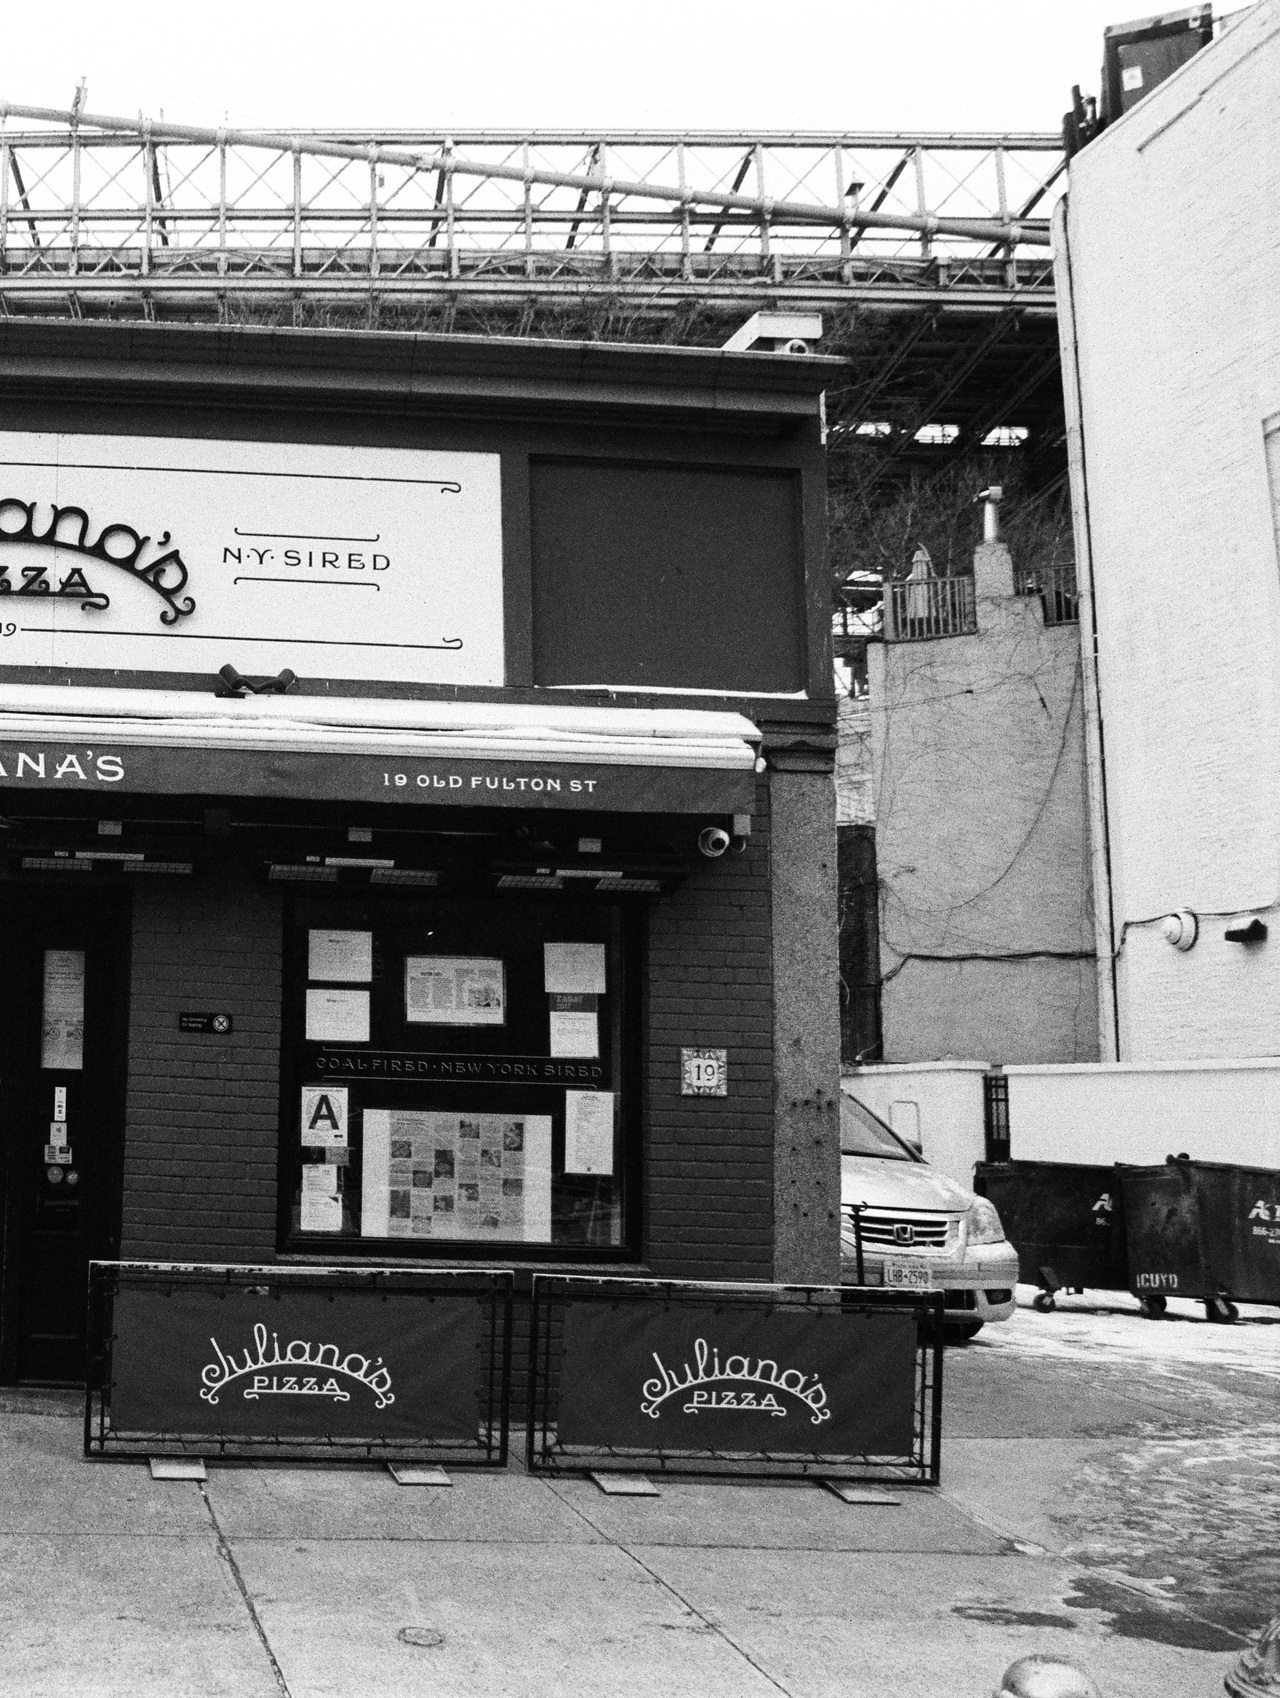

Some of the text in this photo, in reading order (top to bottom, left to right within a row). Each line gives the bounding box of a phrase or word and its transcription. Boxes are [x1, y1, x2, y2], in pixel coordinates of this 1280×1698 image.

[283, 549, 391, 571] SIRED
[383, 773, 598, 792] 19 OLD FULTON ST
[316, 1057, 603, 1079] COAL FIRED NEW YORK SIRED
[694, 1063, 715, 1081] 19
[308, 1094, 340, 1130] A
[200, 1322, 393, 1393] Juliana's
[253, 1375, 342, 1393] PIZZA
[642, 1337, 828, 1409] Juliana's
[693, 1390, 779, 1409] PIZZA
